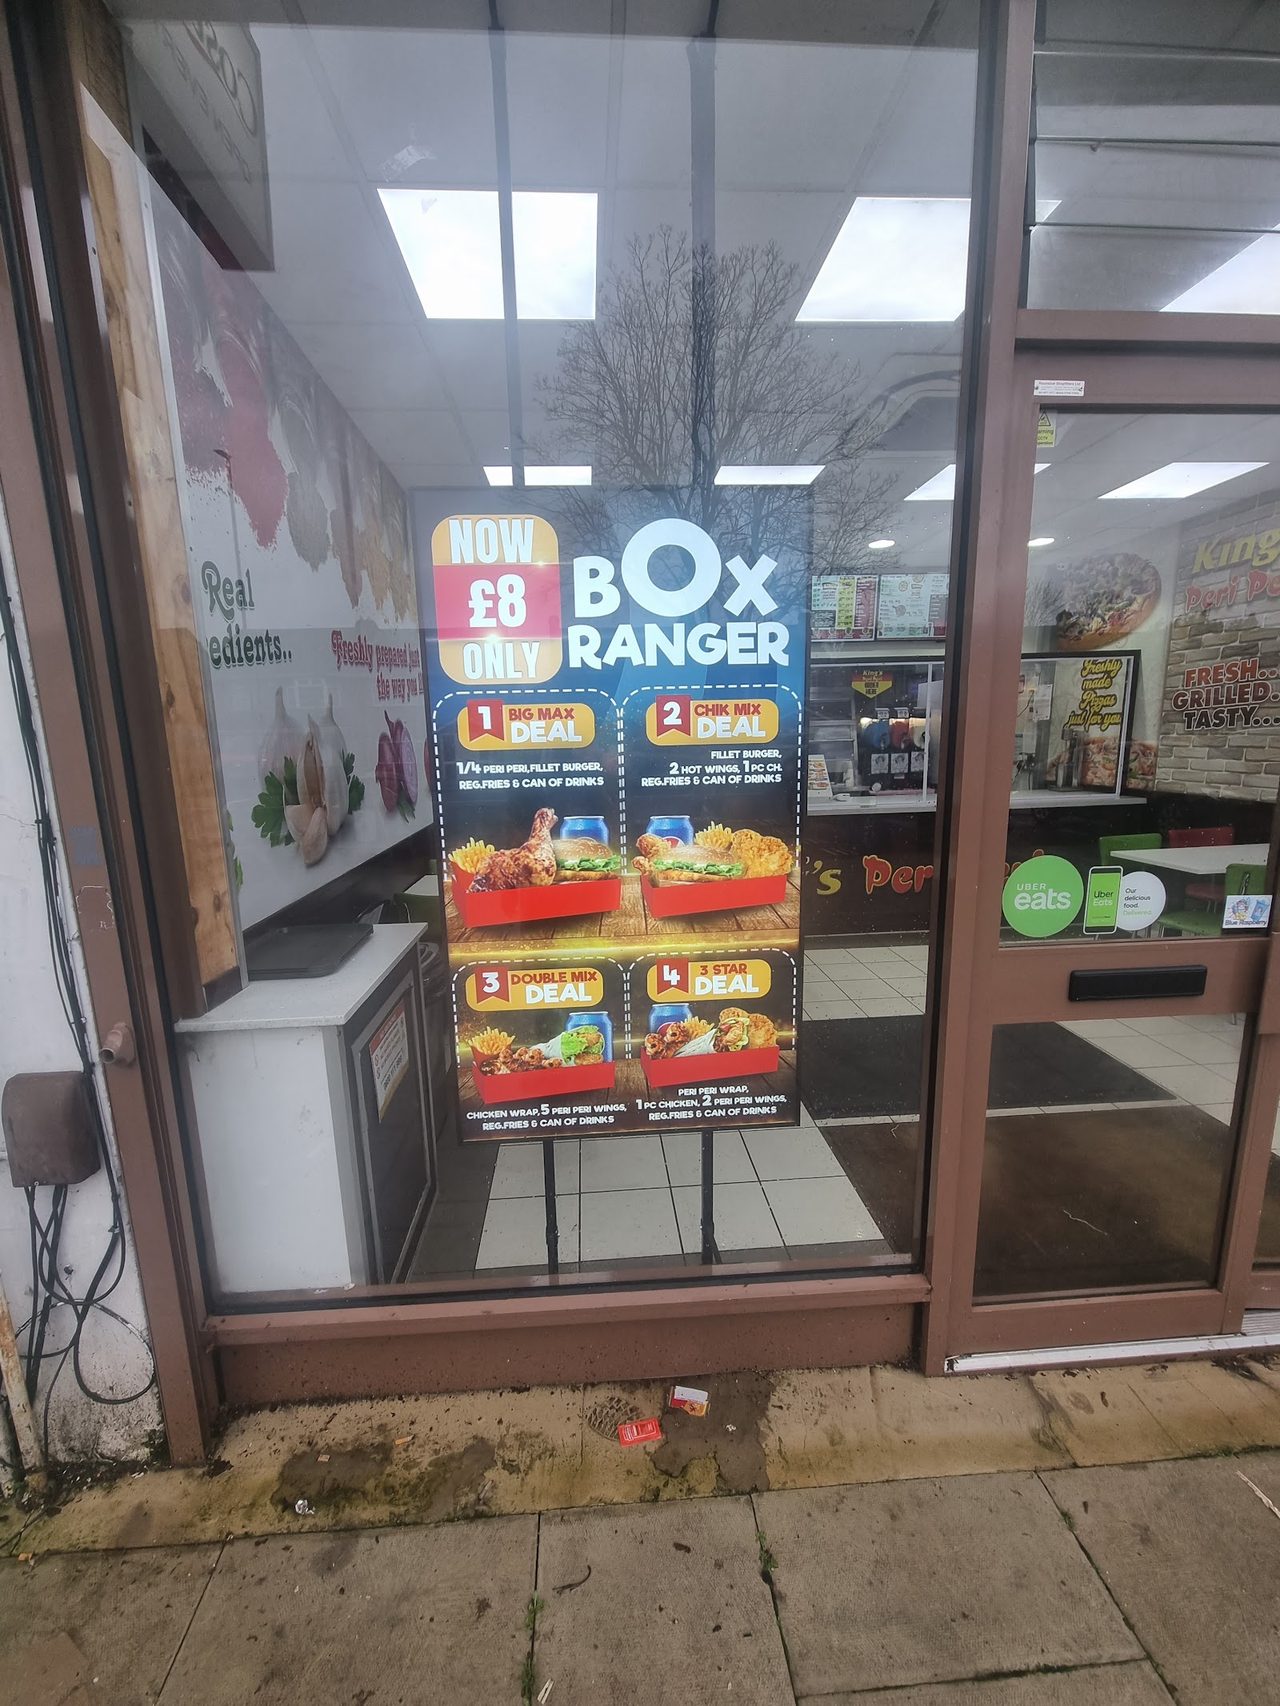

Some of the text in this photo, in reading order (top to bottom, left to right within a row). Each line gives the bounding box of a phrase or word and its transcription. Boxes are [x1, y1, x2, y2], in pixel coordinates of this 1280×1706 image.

[449, 518, 534, 564] NOW
[1192, 528, 1280, 574] King
[573, 517, 778, 618] BOX
[201, 560, 255, 622] Real
[468, 573, 527, 628] £8
[1185, 574, 1240, 613] Peri
[205, 623, 292, 668] edients..
[331, 630, 373, 672] Freshly
[375, 642, 408, 673] prepared
[567, 621, 789, 670] RANGER
[463, 641, 540, 680] ONLY
[1081, 658, 1123, 679] Freshly
[376, 672, 390, 700] the
[391, 678, 406, 703] way
[406, 677, 418, 702] you
[1082, 672, 1113, 691] made
[694, 702, 762, 716] CHIK MIX
[1079, 689, 1117, 712] Pizzas
[478, 706, 492, 730] 1
[508, 707, 575, 721] BIG MAX
[663, 701, 682, 726] 2
[1063, 709, 1088, 728] just
[511, 720, 582, 744] DEAL
[697, 715, 766, 739] DEAL
[710, 749, 782, 759] FILLET BURGER,
[456, 761, 482, 774] 1/4
[483, 764, 504, 774] PERI
[562, 762, 603, 772] BURGER,
[669, 762, 679, 775] 2
[681, 765, 702, 774] HOT
[704, 763, 741, 774] WINGS,
[513, 779, 520, 788] &
[522, 778, 547, 788] CAN
[549, 777, 563, 787] OF
[565, 776, 604, 787] DRINKS
[693, 776, 700, 785] &
[702, 775, 726, 785] CAN
[727, 774, 742, 784] OF
[744, 773, 782, 784] DRINKS
[1016, 883, 1046, 891] UBER
[1093, 890, 1114, 898] Uber
[1014, 888, 1071, 910] eats
[1124, 894, 1151, 902] delicious
[511, 971, 598, 986] DOUBLE MIX
[663, 964, 680, 986] 4
[700, 963, 747, 975] 3 STAR
[482, 971, 500, 993] 3
[695, 974, 759, 995] DEAL
[525, 982, 592, 1004] DEAL
[678, 1085, 749, 1096] PERI PERI WRAP,
[466, 1110, 508, 1120] CHICKEN
[552, 1106, 571, 1115] PERI
[573, 1105, 591, 1114] PERI
[594, 1103, 627, 1113] WINGS,
[658, 1099, 700, 1109] CHICKEN,
[702, 1095, 712, 1106] 2
[714, 1097, 732, 1106] PERI
[734, 1096, 753, 1104] PERI
[754, 1094, 787, 1103] WINGS,
[696, 1110, 702, 1118] &
[704, 1108, 726, 1117] CAN
[728, 1108, 741, 1116] OF
[742, 1105, 777, 1115] DRINKS
[531, 1120, 537, 1128] &
[539, 1118, 562, 1127] CAN
[564, 1118, 577, 1126] OF
[579, 1115, 615, 1125] DRINKS
